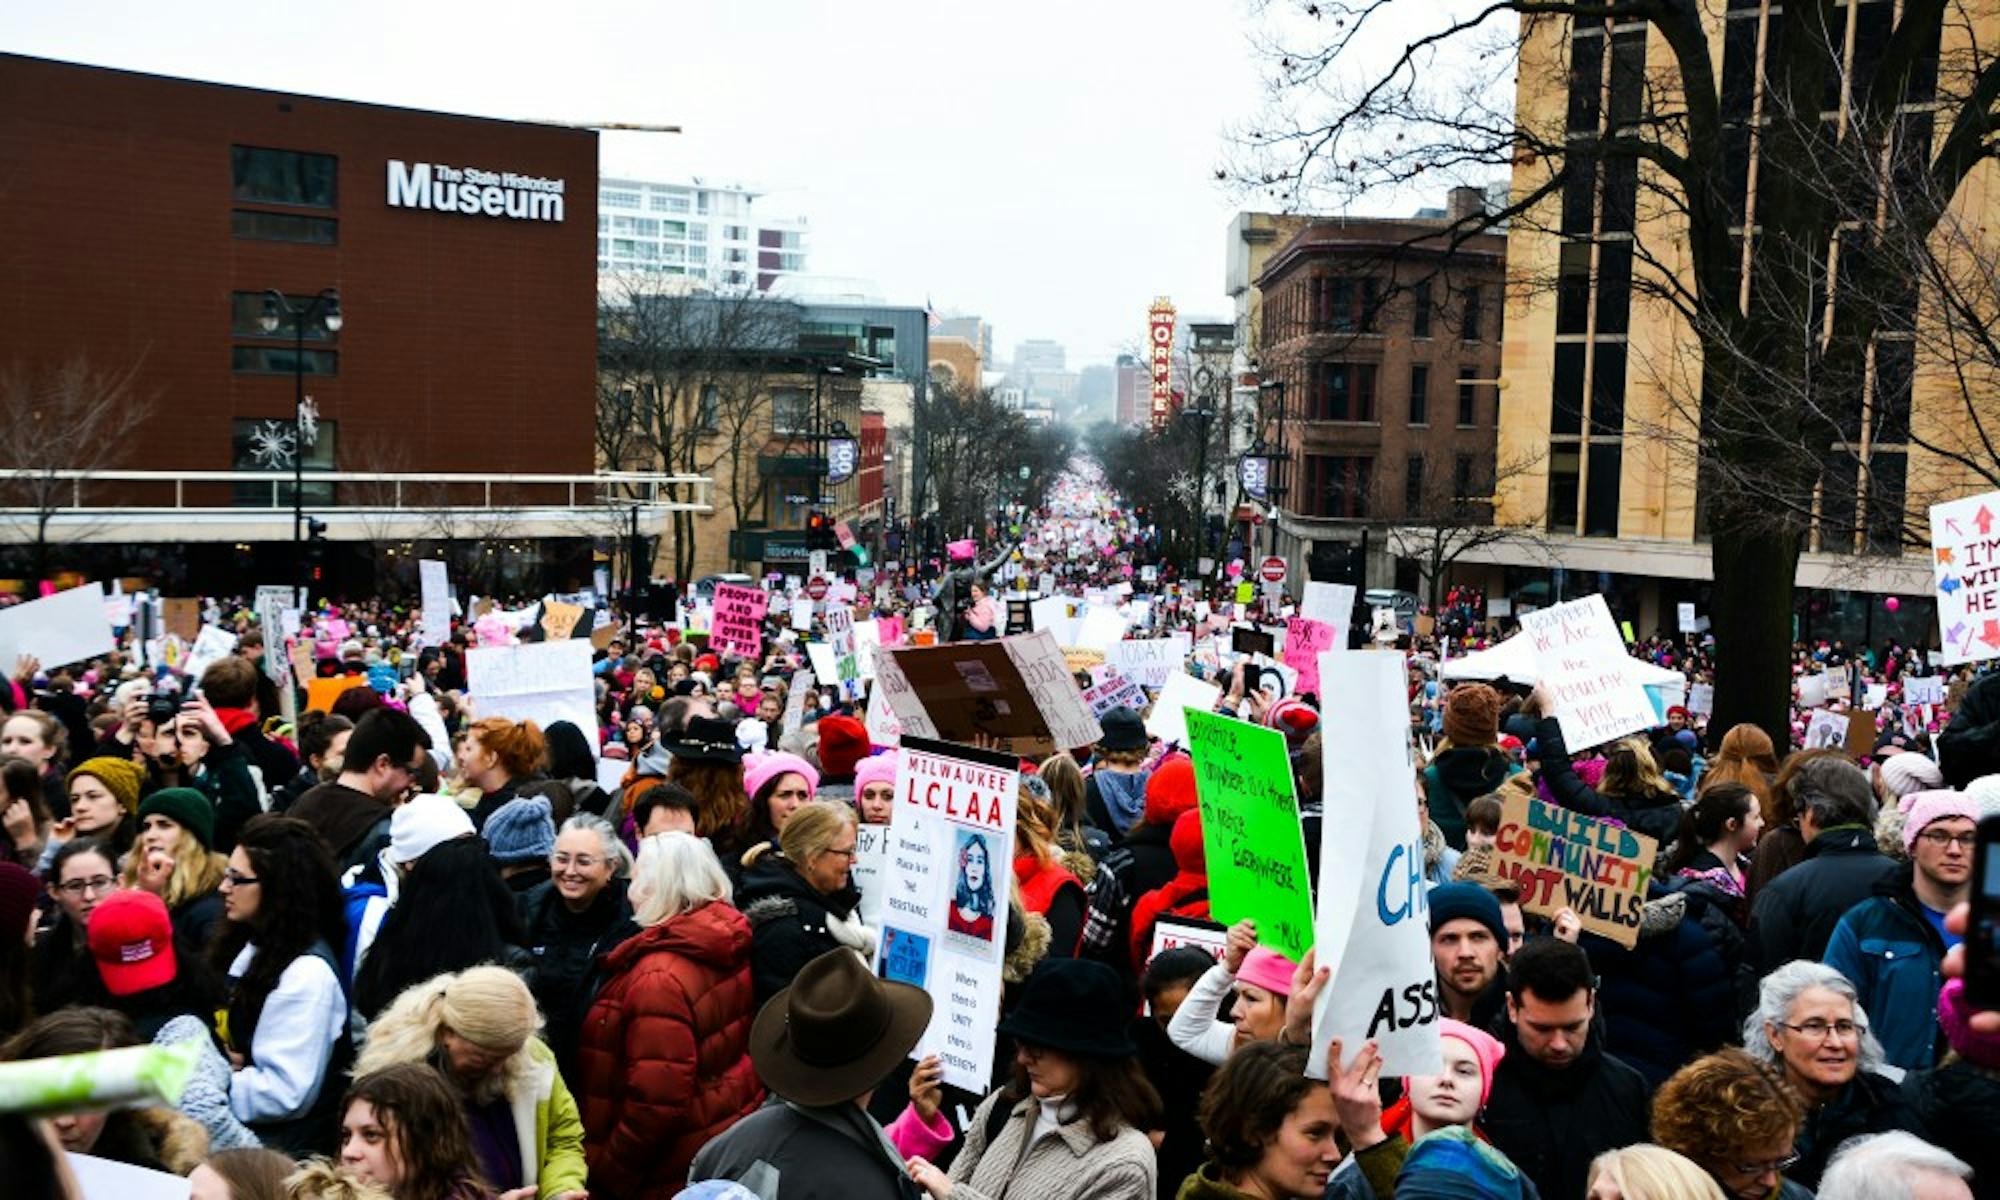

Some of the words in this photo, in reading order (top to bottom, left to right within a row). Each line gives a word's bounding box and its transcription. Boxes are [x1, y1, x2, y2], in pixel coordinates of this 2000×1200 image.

[387, 160, 564, 222] Museum
[435, 165, 463, 182] The
[464, 168, 501, 187] State
[502, 173, 564, 193] Historical
[1153, 325, 1170, 434] ORPHEU
[1243, 459, 1258, 488] 100
[1961, 567, 2000, 588] WIT
[719, 588, 764, 604] PEOPLE
[727, 602, 752, 616] AND
[1967, 590, 1997, 614] HE
[716, 612, 759, 628] PLANET
[722, 626, 753, 640] OVER
[714, 636, 756, 654] PRFIT
[907, 756, 1007, 793] MILWAUKEE
[907, 778, 1003, 827] LCLAA
[1528, 799, 1640, 858] BUILD
[1495, 823, 1651, 893] COMMUNITY
[1377, 840, 1424, 926] CH
[1497, 860, 1564, 906] NOT
[888, 897, 928, 919] RESISTANCE
[1564, 878, 1642, 928] WALLS
[1366, 980, 1438, 1039] ASS
